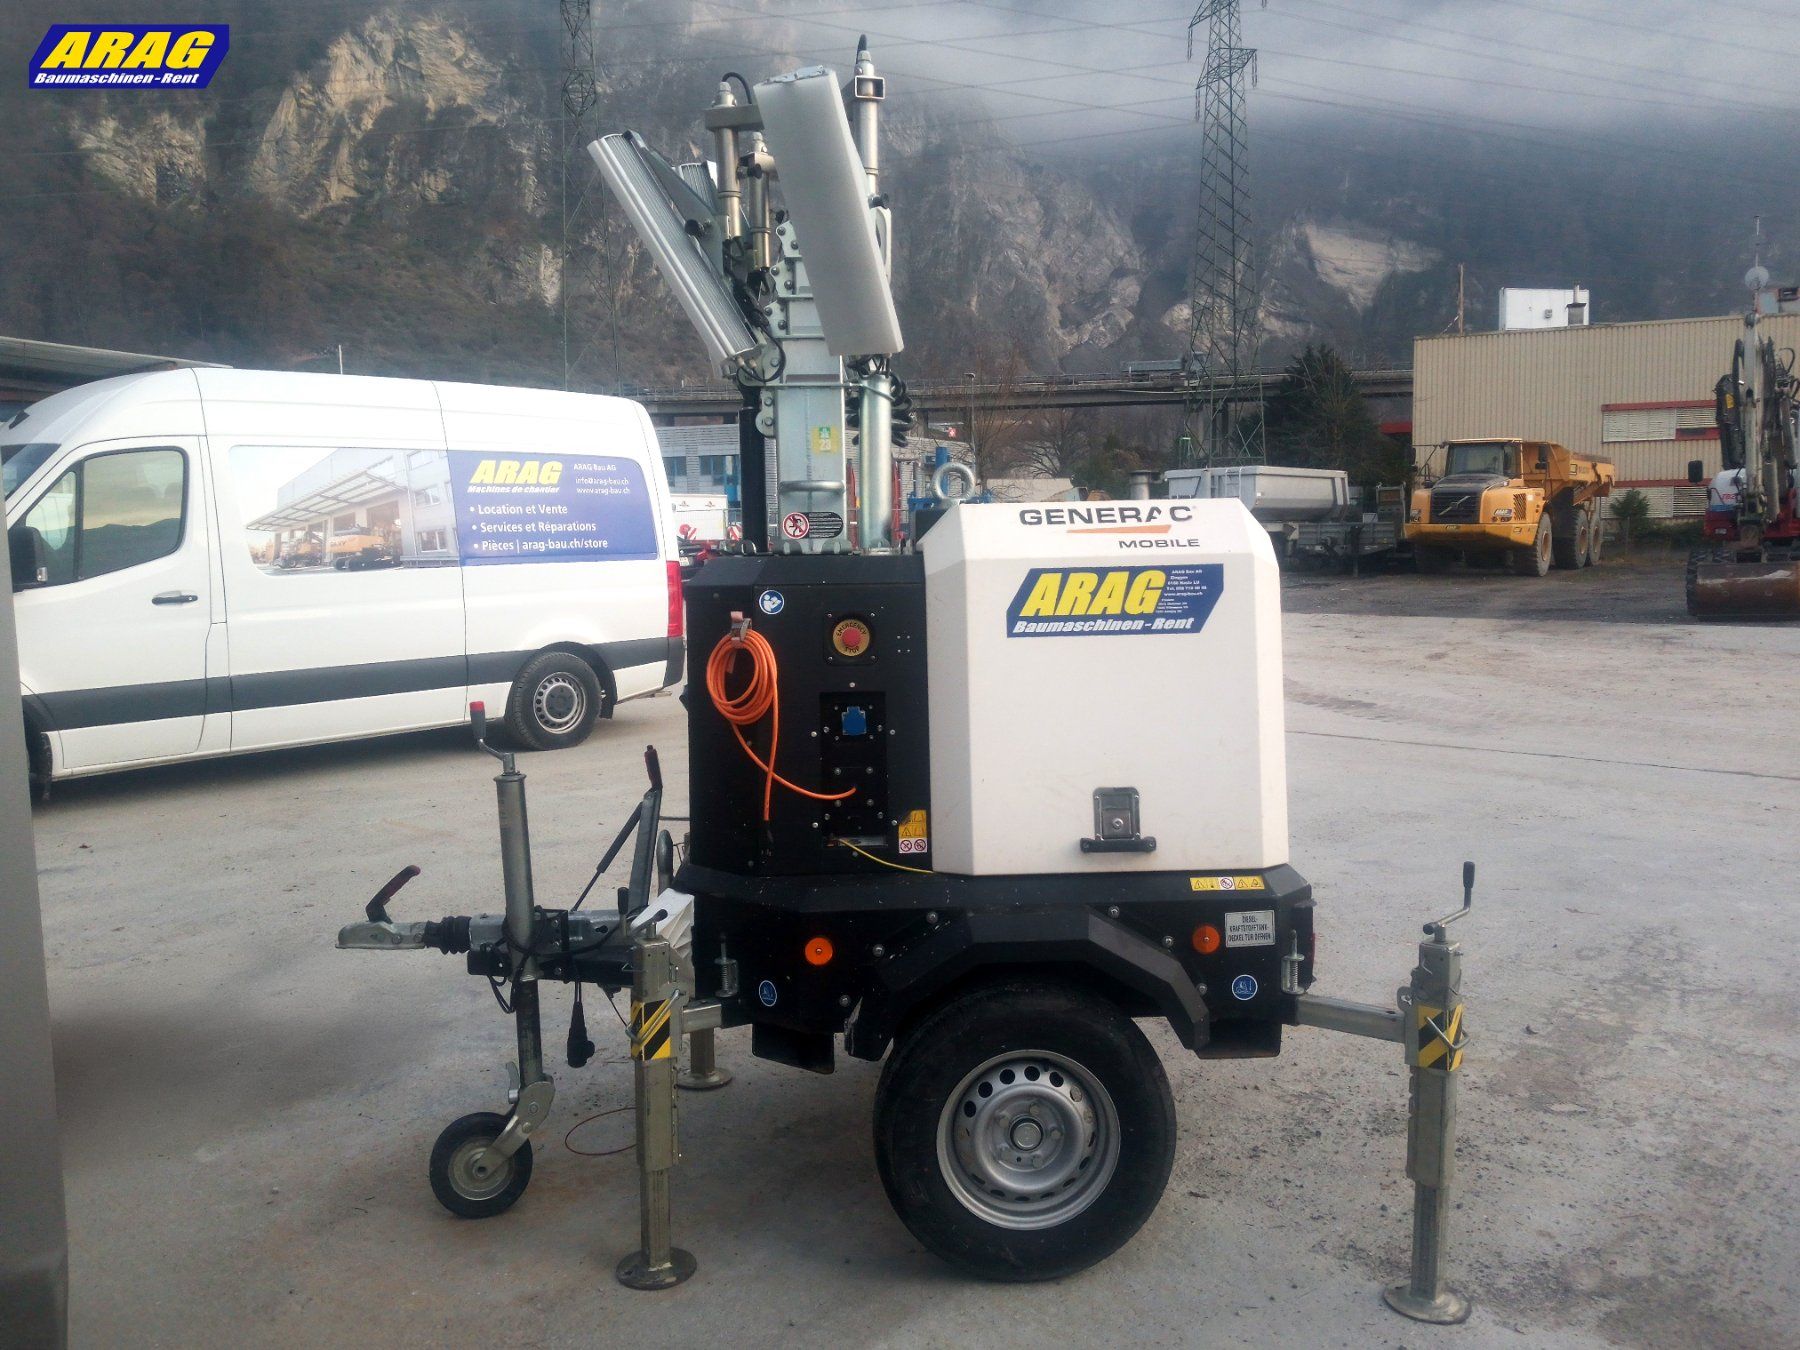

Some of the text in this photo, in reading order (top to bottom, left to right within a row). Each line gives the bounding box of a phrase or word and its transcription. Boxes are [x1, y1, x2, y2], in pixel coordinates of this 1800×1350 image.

[469, 460, 563, 485] ARAG
[467, 485, 511, 493] Machines
[511, 485, 523, 493] de
[478, 504, 568, 515] Location et Vente
[1019, 506, 1193, 526] GENERAC
[480, 521, 597, 533] Services et Réparations
[482, 538, 609, 551] Pièces arag-bau.ch/store
[1118, 538, 1200, 549] MOBILE
[1019, 569, 1167, 617] ARAG
[1013, 617, 1195, 634] Baumaschinen-Rent
